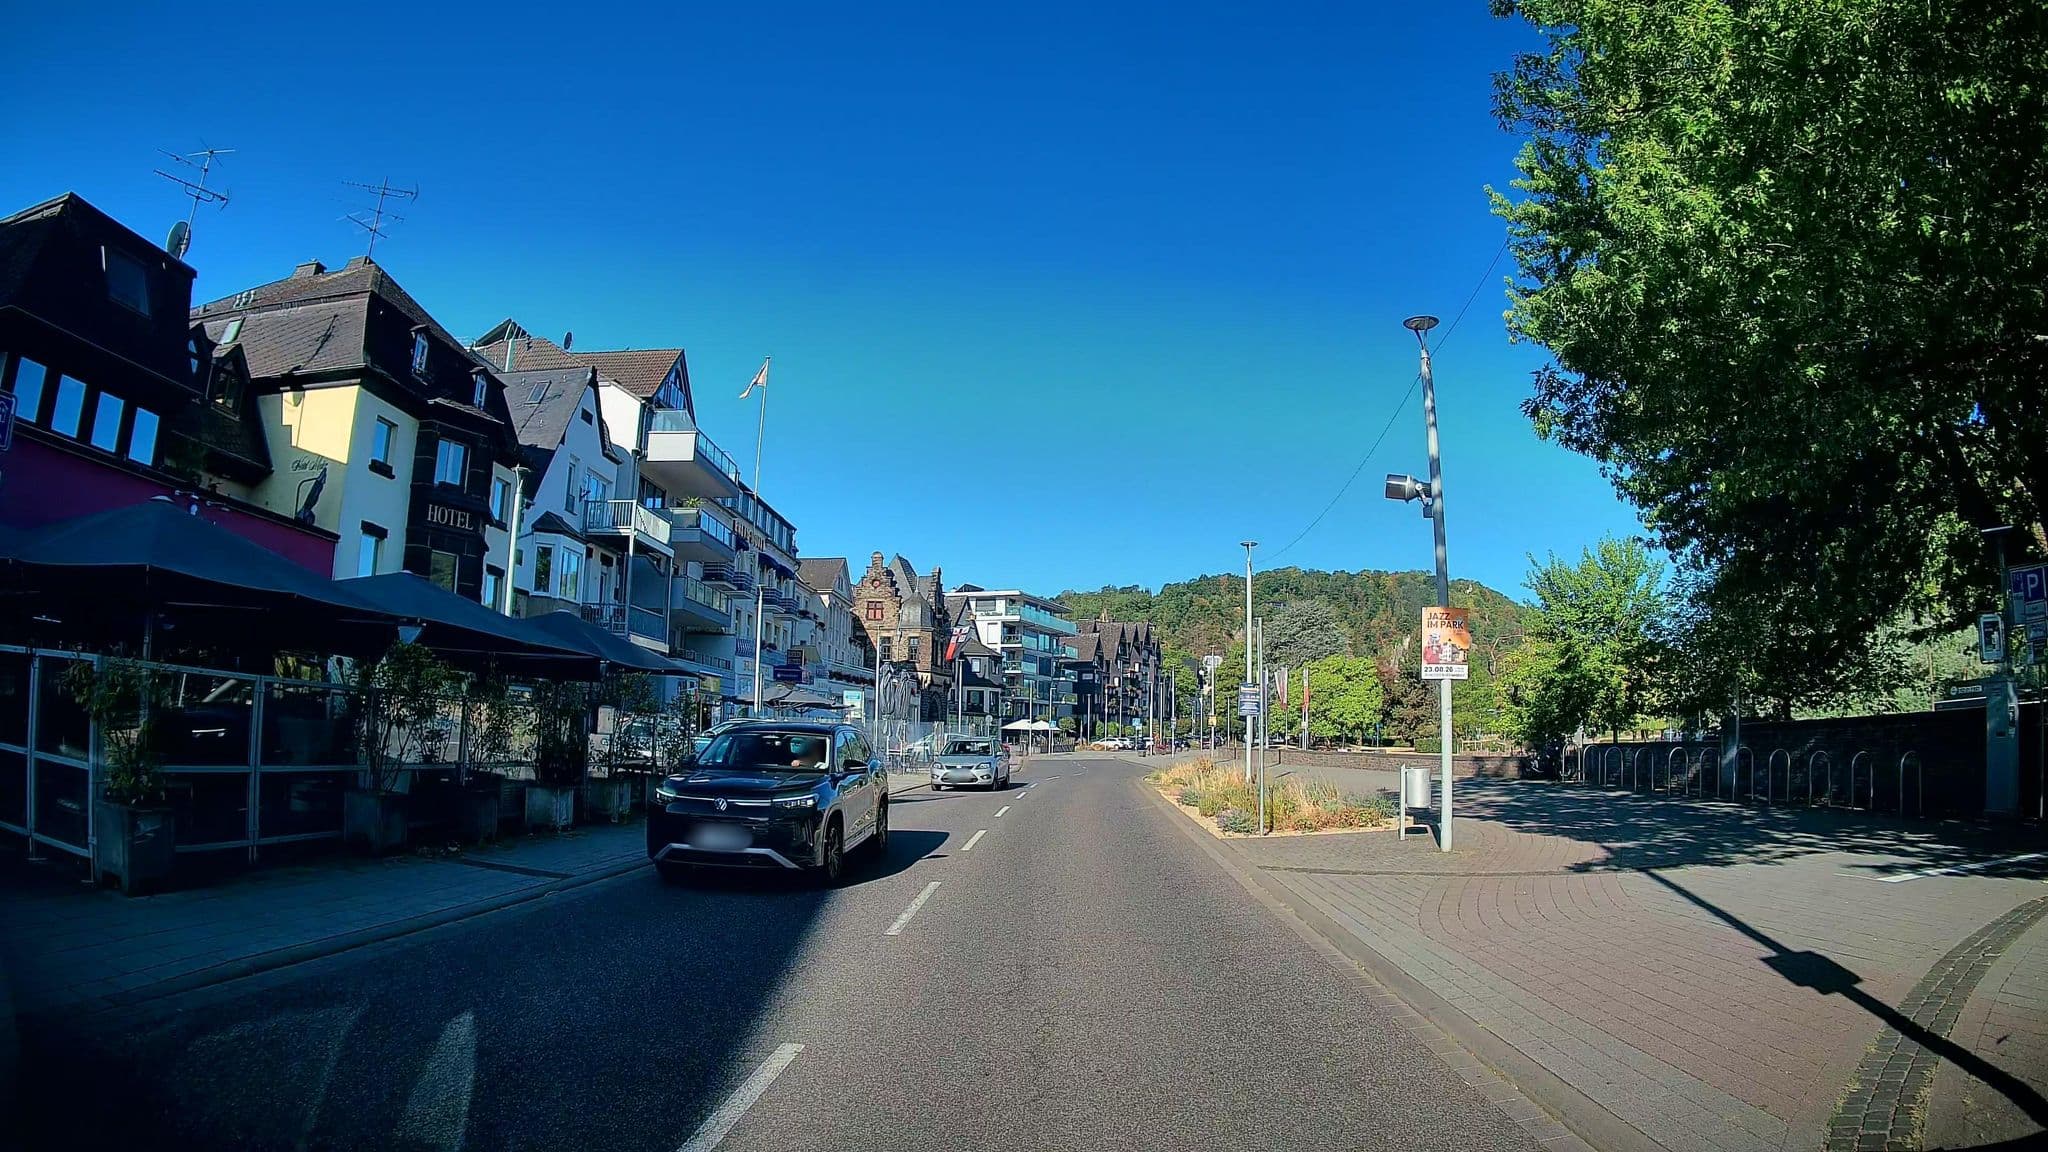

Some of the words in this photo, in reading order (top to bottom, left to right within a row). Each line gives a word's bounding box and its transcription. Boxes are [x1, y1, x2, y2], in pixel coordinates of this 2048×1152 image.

[427, 504, 474, 530] HOTEL
[2026, 573, 2039, 599] P
[1427, 612, 1451, 621] JAZZ
[1427, 620, 1438, 629] IM
[1440, 620, 1464, 629] PARK
